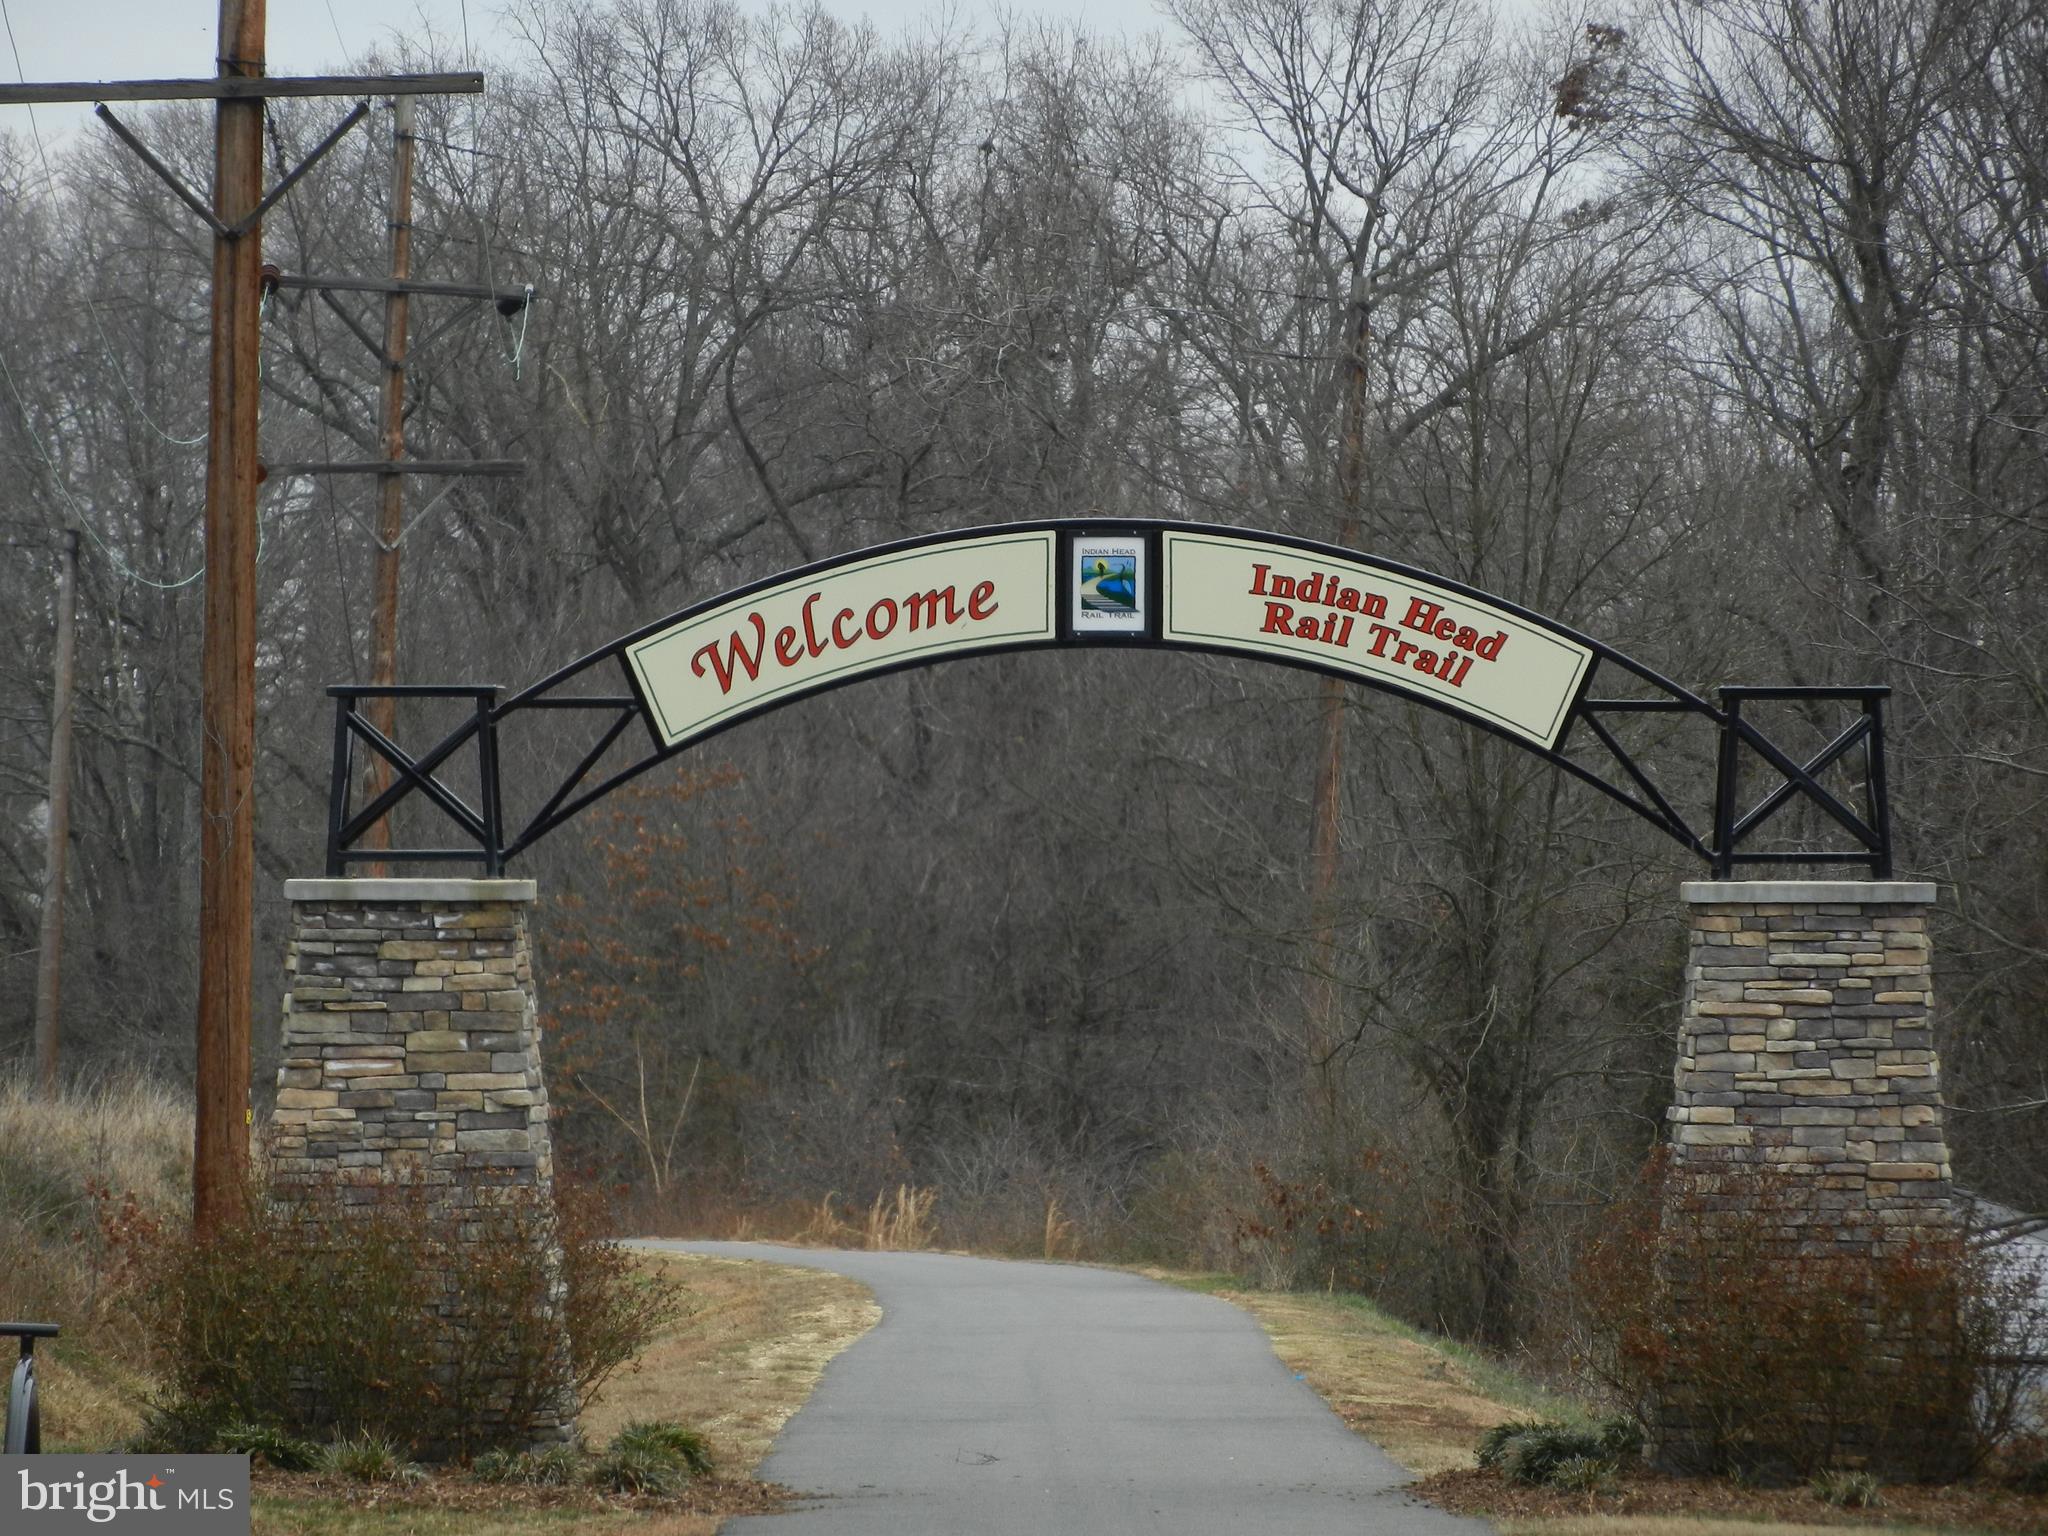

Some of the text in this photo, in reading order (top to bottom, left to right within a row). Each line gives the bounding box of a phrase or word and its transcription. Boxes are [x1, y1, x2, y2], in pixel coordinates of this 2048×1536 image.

[690, 580, 999, 695] Welcome
[1248, 564, 1508, 663] Indian Head
[1259, 602, 1474, 688] Rail Trail
